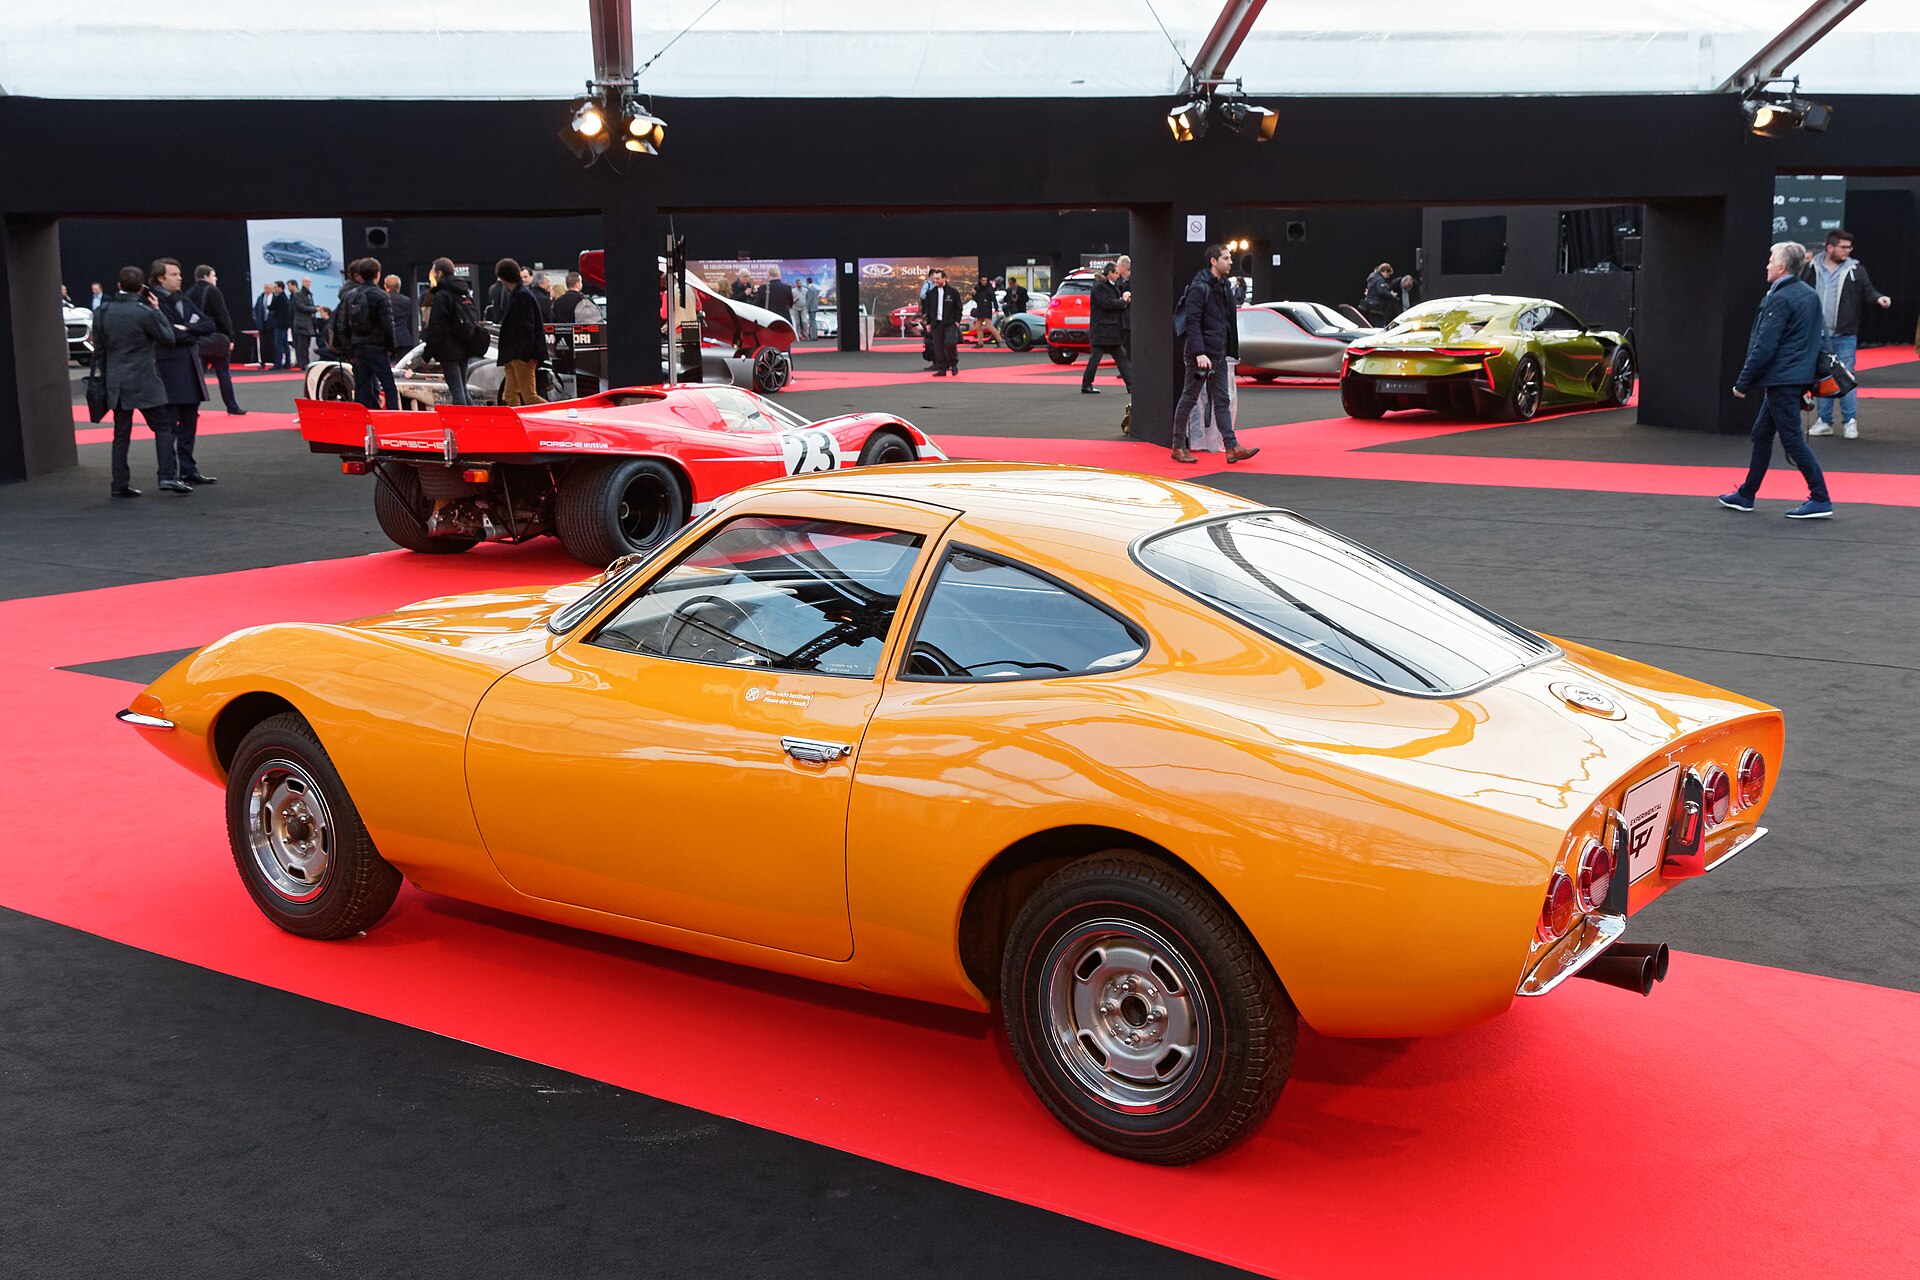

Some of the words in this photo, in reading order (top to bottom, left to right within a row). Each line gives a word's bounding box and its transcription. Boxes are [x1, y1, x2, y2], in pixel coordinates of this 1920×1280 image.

[380, 439, 446, 449] PORSCHE
[540, 440, 582, 448] PORSCHE
[783, 430, 835, 475] 23
[1630, 804, 1662, 826] EXPERIMENTAL
